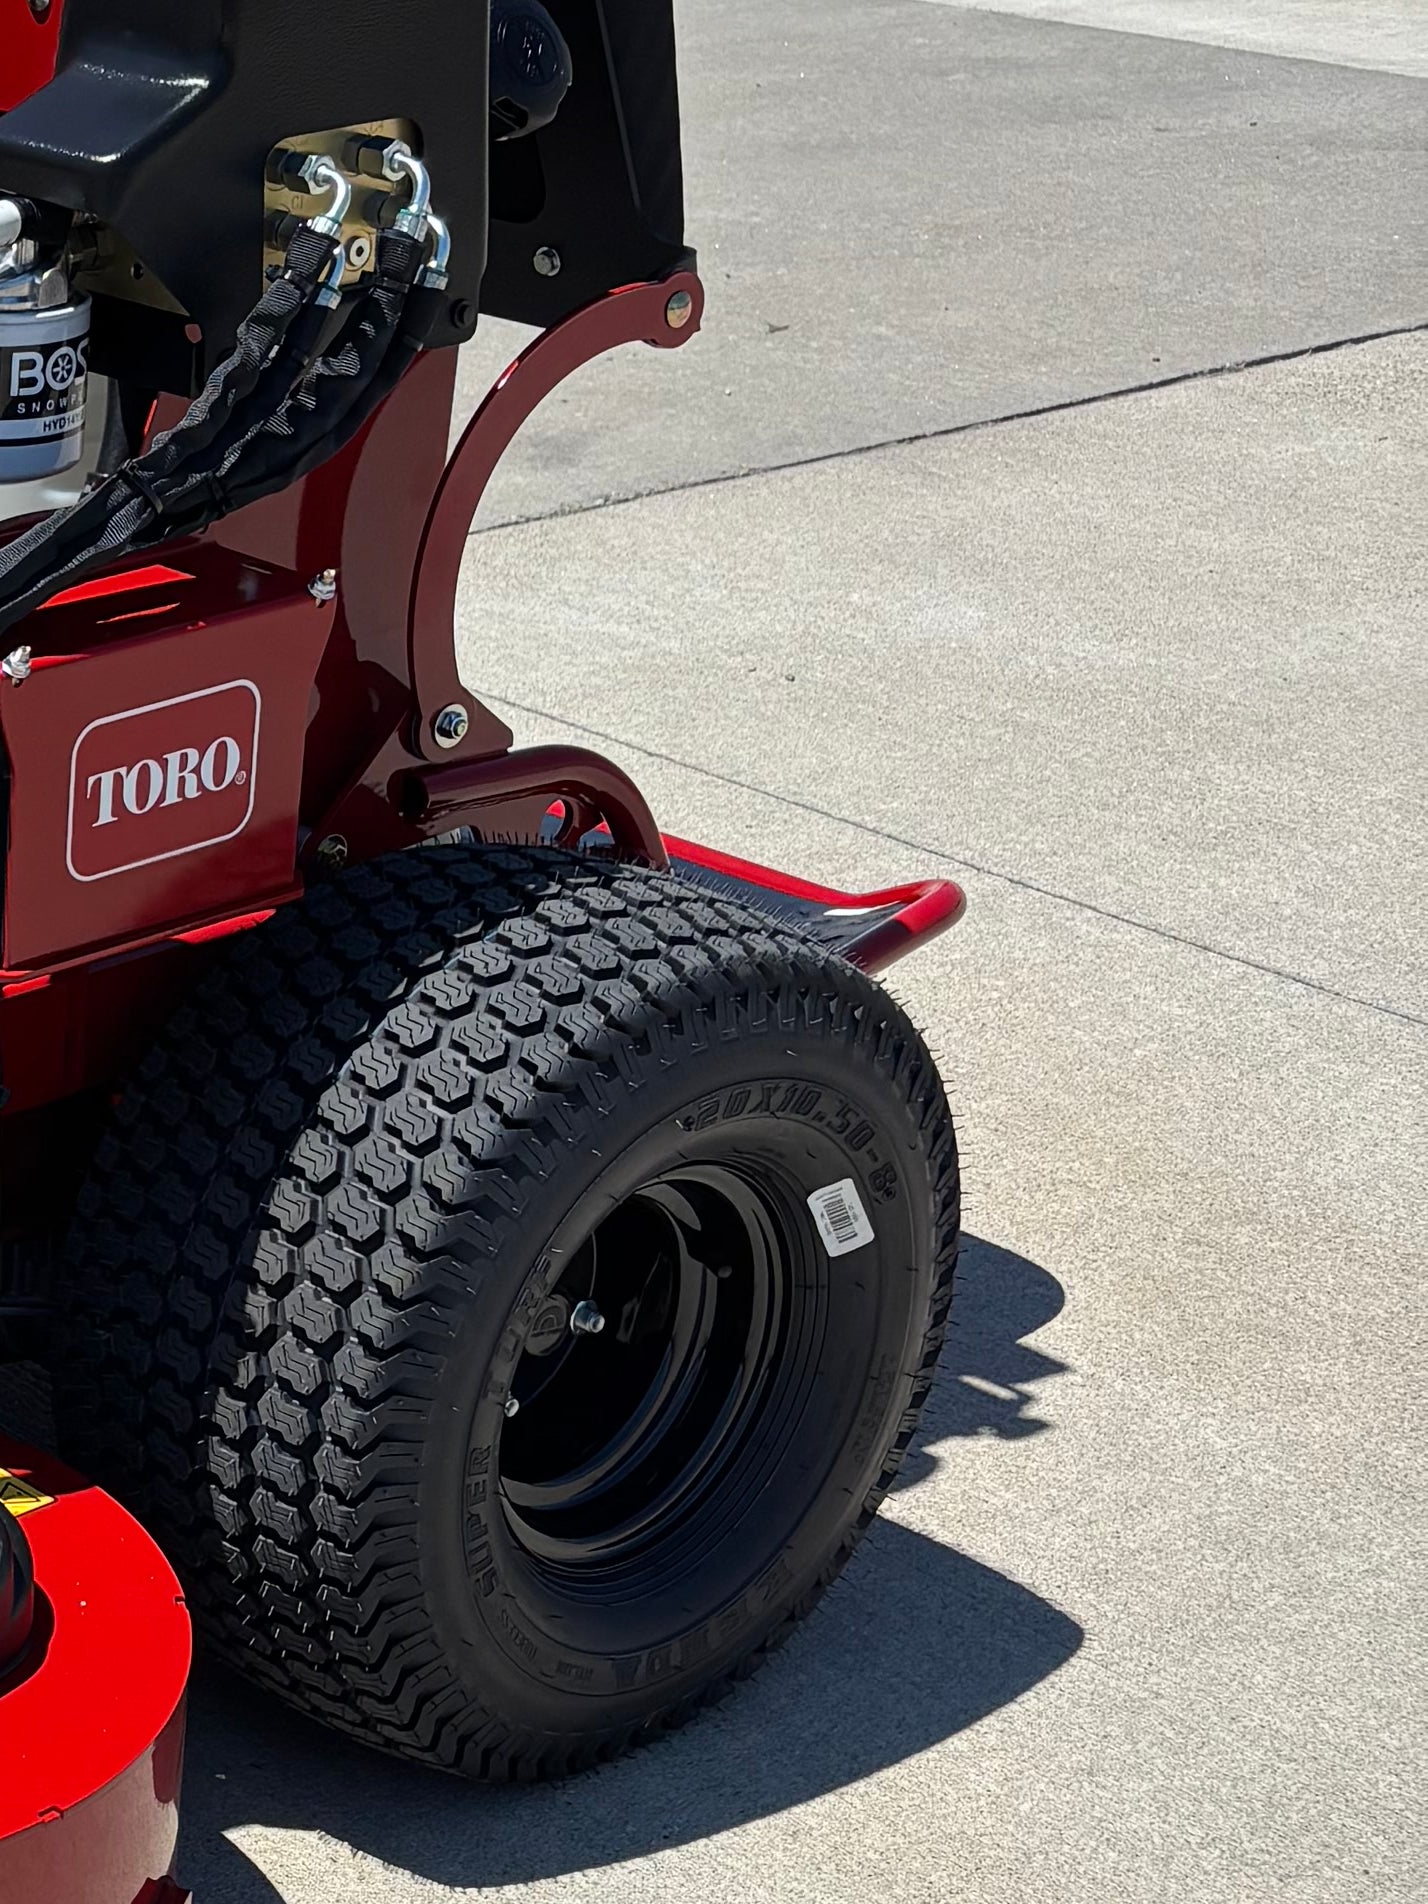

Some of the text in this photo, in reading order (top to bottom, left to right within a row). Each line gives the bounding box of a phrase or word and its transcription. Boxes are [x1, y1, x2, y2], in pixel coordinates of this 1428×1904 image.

[17, 393, 82, 413] SNOWP
[87, 736, 241, 827] TORO
[465, 1444, 499, 1598] SUPER
